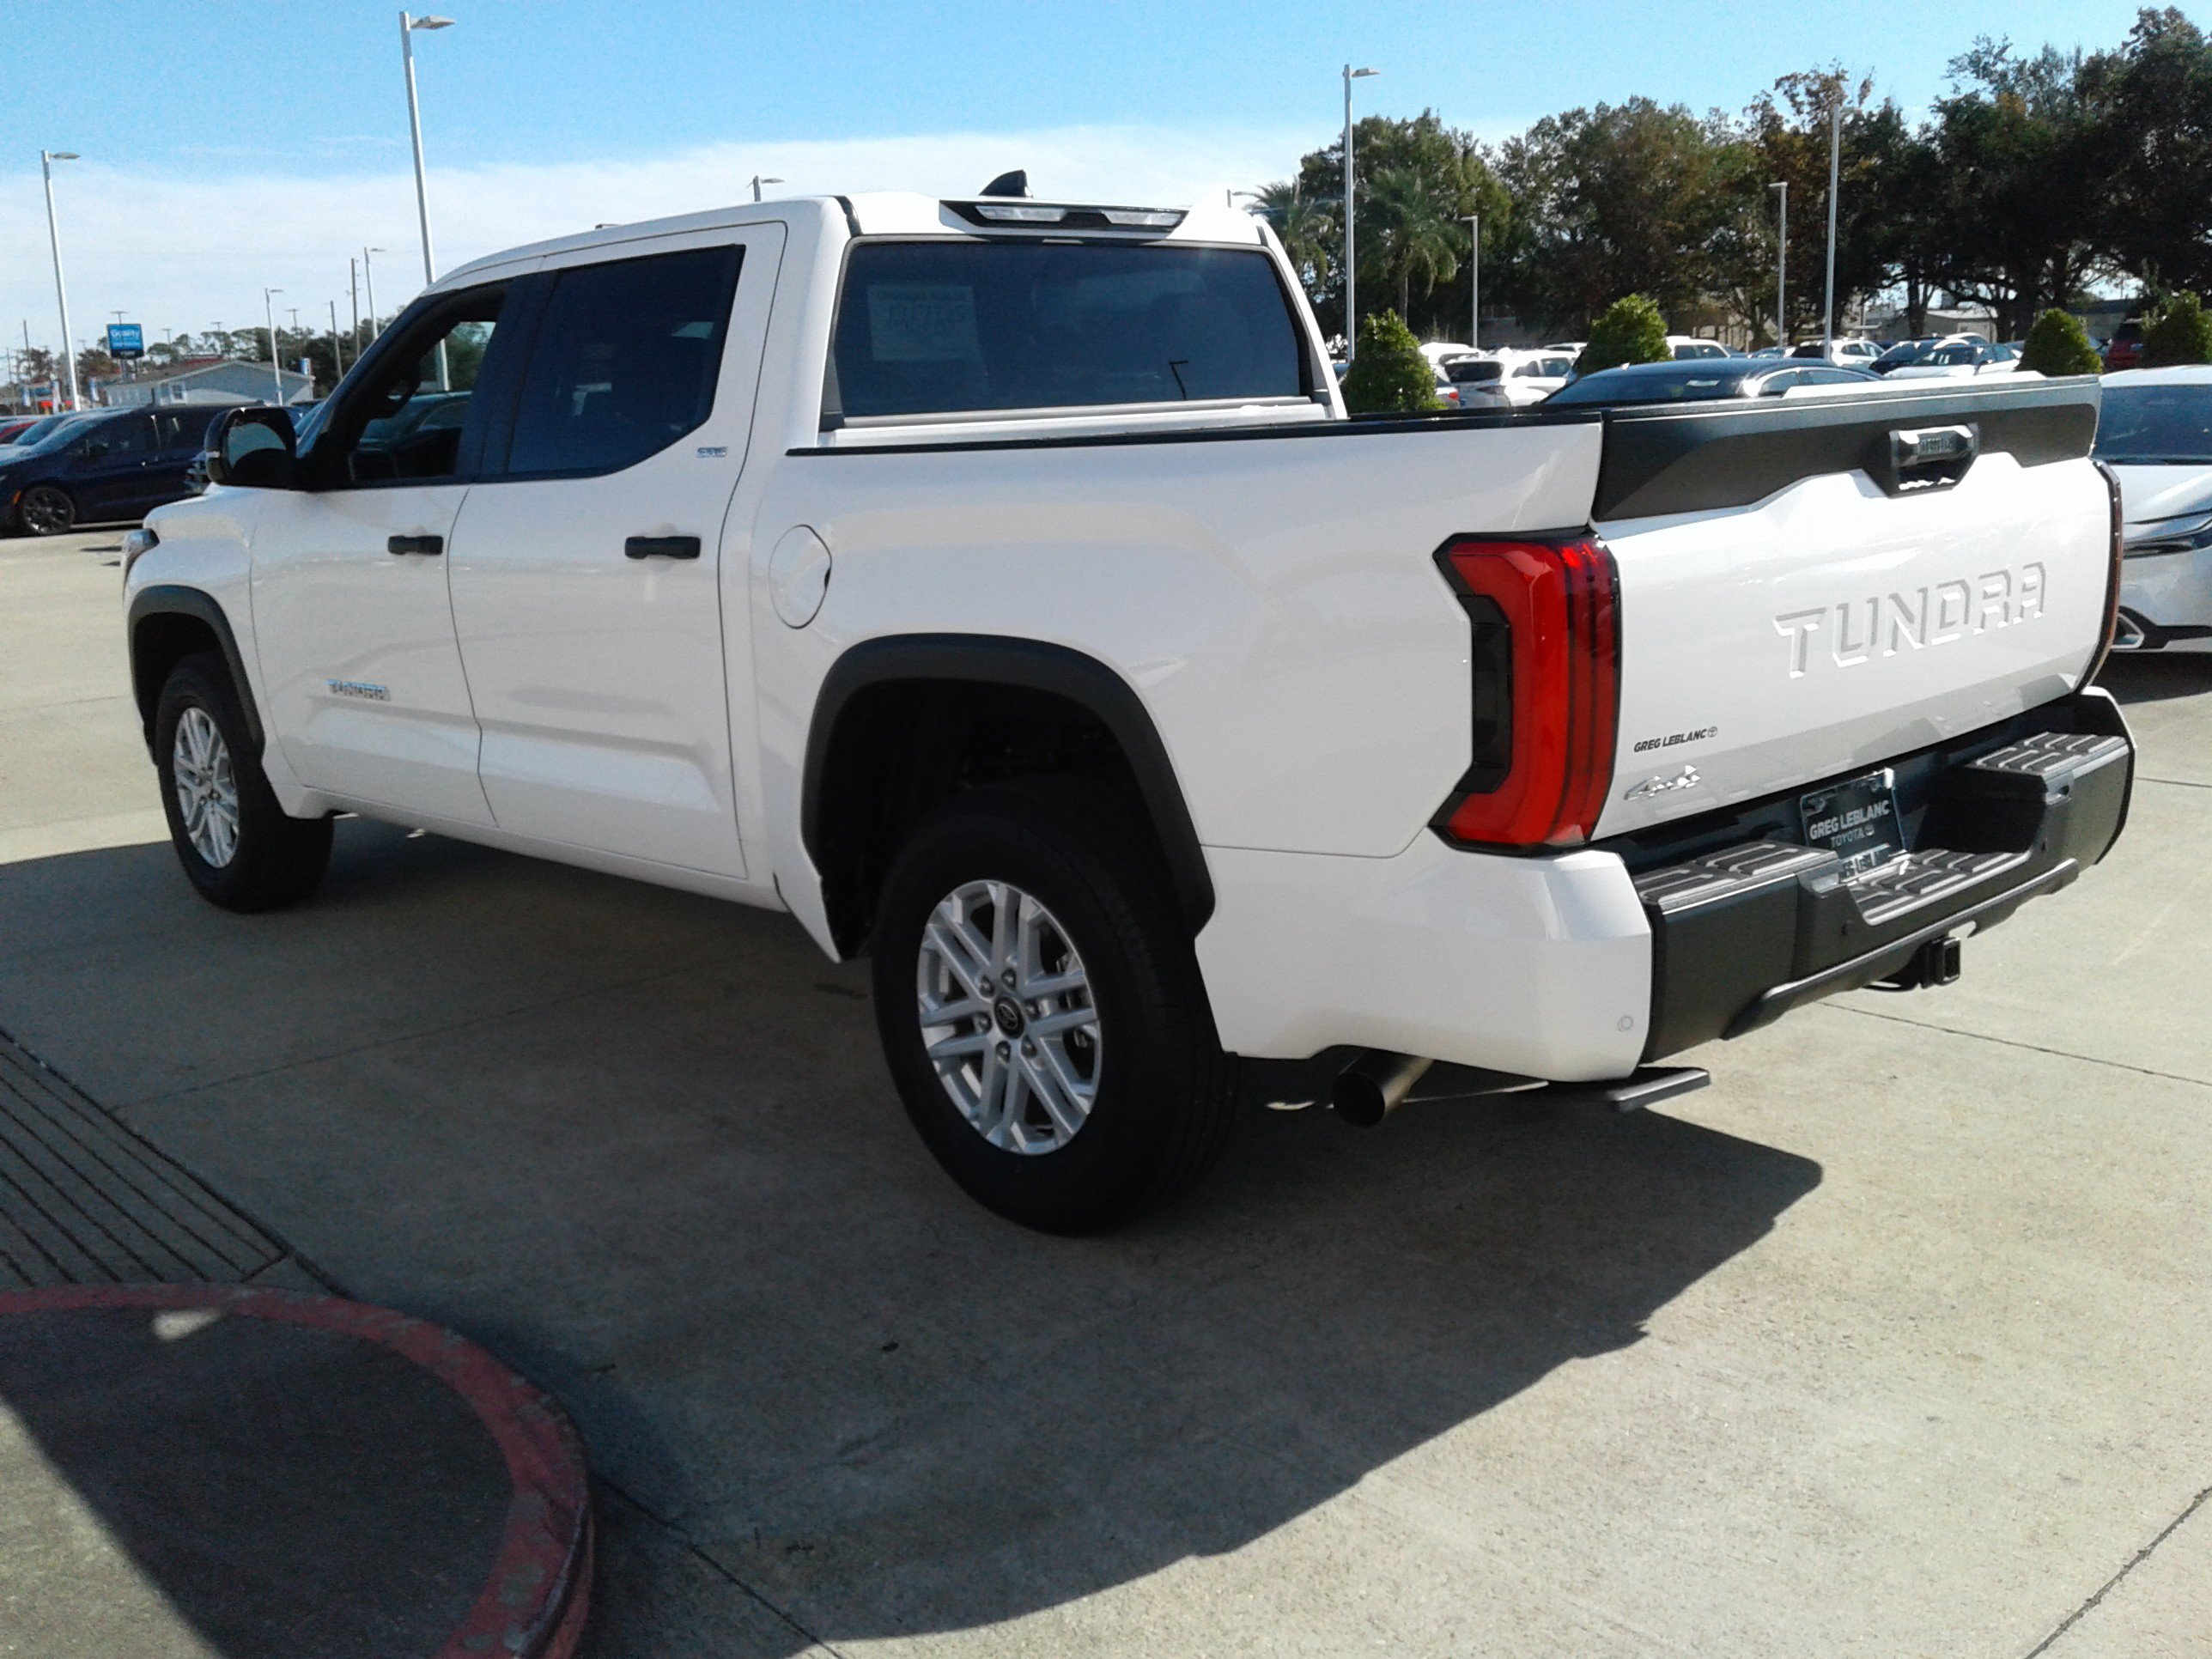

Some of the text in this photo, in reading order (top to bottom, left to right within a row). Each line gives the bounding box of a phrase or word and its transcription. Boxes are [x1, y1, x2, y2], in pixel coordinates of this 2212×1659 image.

[1772, 562, 2046, 679] TUNDRA
[1633, 728, 1708, 753] GREG LEBLANC
[1809, 799, 1890, 840] GREG LEBLANC
[1831, 827, 1865, 848] TOYOTA
